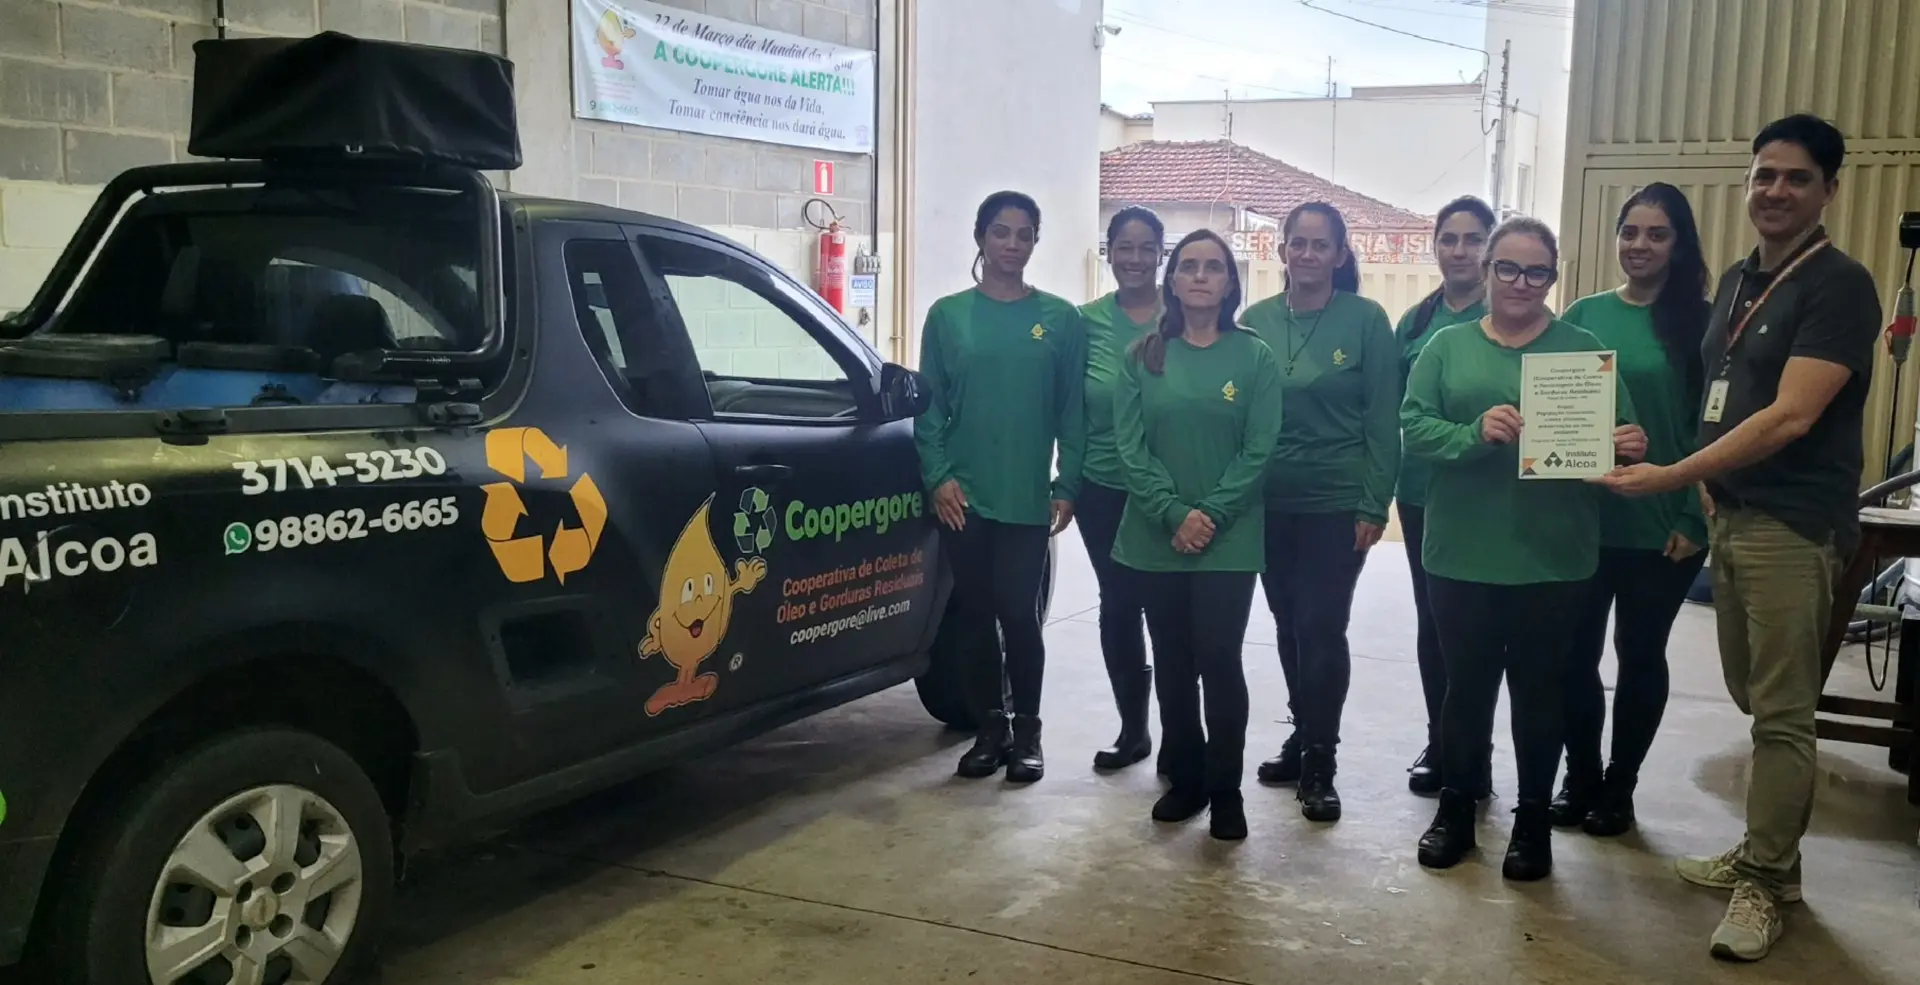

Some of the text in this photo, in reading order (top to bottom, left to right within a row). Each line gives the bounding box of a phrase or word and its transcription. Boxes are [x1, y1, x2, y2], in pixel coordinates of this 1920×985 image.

[672, 19, 689, 36] de
[692, 23, 734, 48] Março
[736, 34, 756, 51] dia
[758, 38, 808, 61] Mundial
[654, 40, 668, 62] A
[790, 67, 855, 96] ALERTA!!!
[693, 78, 731, 99] Tomar
[733, 85, 762, 106] água
[763, 94, 782, 108] nos
[784, 94, 797, 110] da
[669, 99, 846, 141] Tomar conciência nos dará água.
[232, 446, 447, 495] 3714-3230
[1564, 459, 1598, 468] Alcoa
[254, 496, 459, 551] 98862-6665
[785, 491, 922, 543] Coopergore
[0, 531, 159, 588] Alcoa
[782, 565, 856, 597] Cooperativa
[858, 558, 874, 578] de
[874, 552, 910, 573] Coleta
[808, 600, 817, 615] e
[820, 586, 872, 612] Gorduras
[874, 569, 924, 597] Residuais
[790, 599, 911, 645] coopergore@live.com
